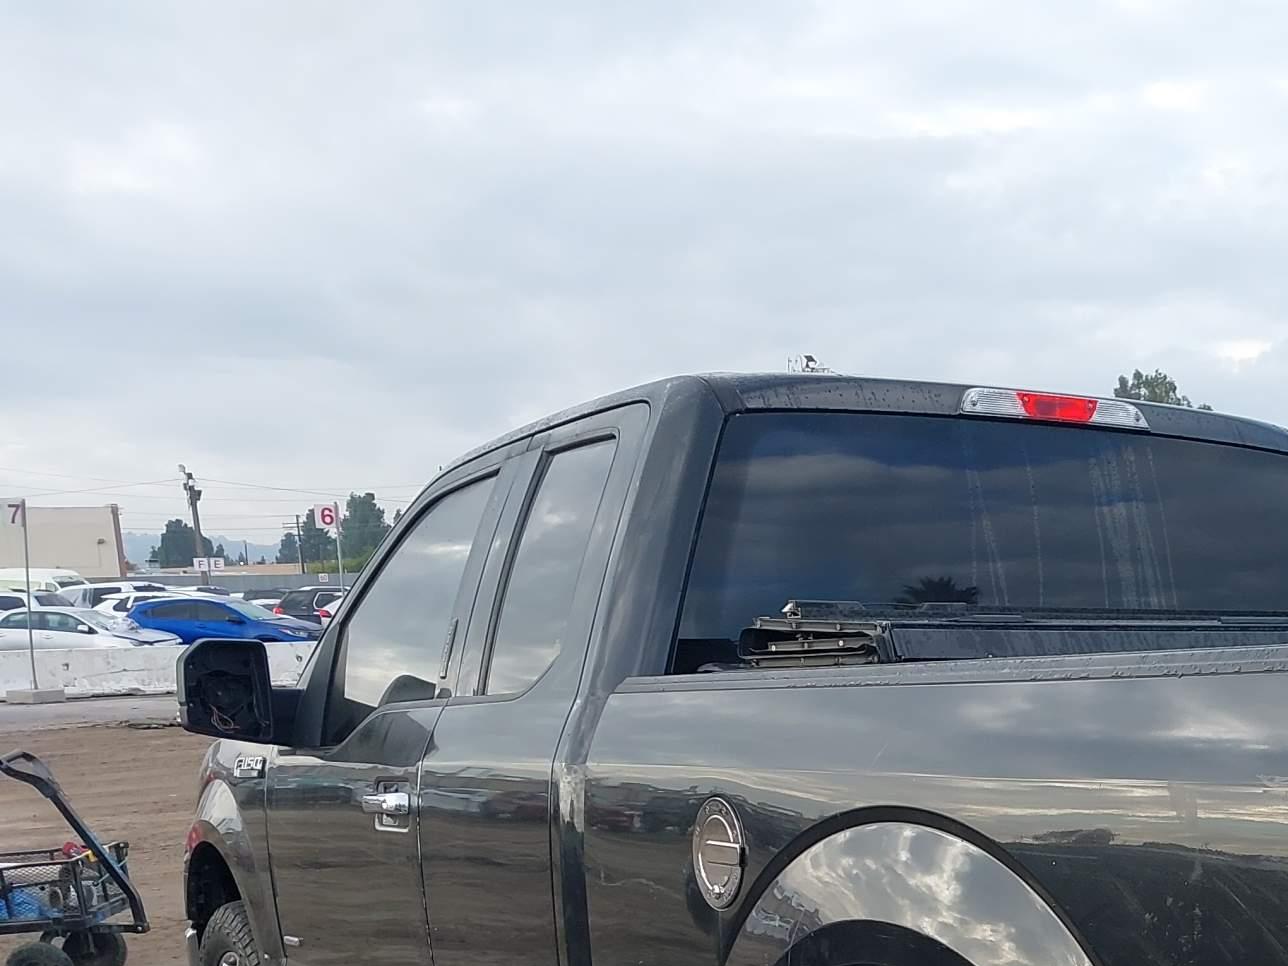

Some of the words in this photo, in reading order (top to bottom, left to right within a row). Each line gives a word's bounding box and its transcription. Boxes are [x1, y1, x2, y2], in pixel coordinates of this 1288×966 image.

[7, 503, 21, 524] 7
[320, 507, 334, 526] 6
[198, 559, 206, 569] F
[214, 559, 221, 569] E
